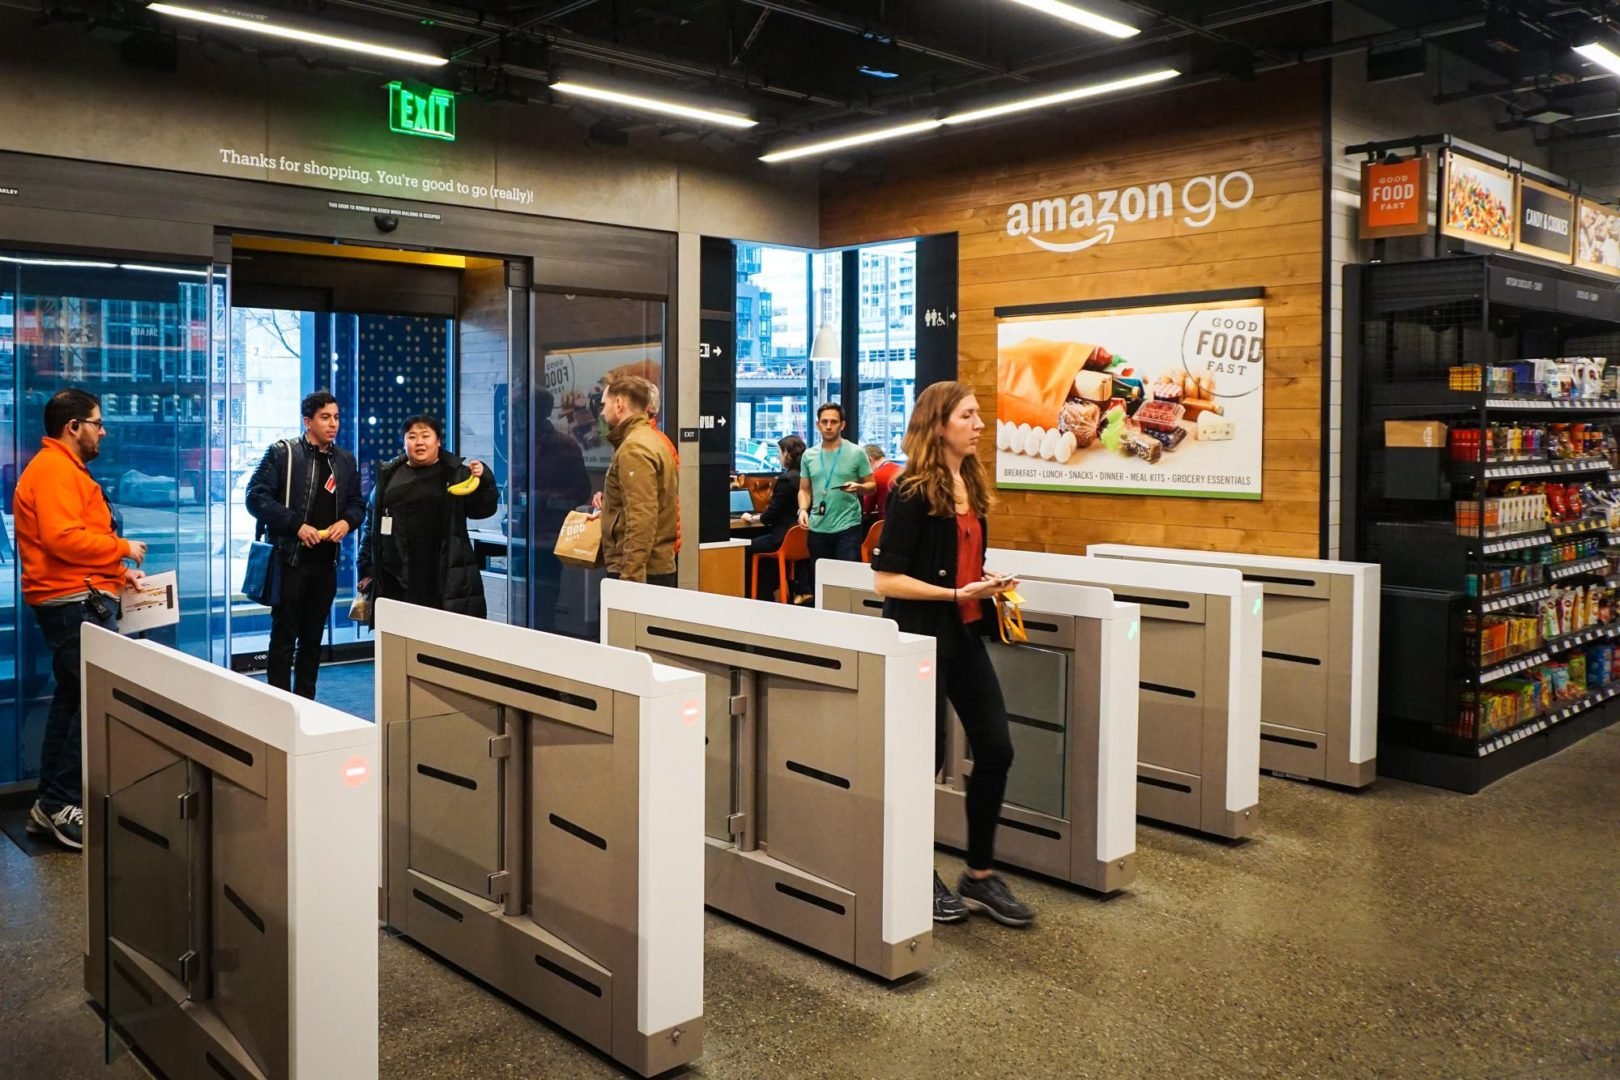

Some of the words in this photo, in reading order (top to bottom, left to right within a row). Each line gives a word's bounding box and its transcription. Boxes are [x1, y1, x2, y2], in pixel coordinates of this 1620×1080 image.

[401, 90, 449, 132] EXIT
[219, 149, 277, 169] Thanks
[279, 156, 301, 172] for
[303, 160, 373, 184] shopping.
[376, 170, 419, 188] You're
[422, 178, 454, 192] good
[456, 181, 470, 194] to
[472, 186, 488, 197] go
[489, 184, 534, 205] (really)!
[1378, 174, 1408, 184] GOOD
[1372, 183, 1415, 203] FOOD
[1006, 181, 1174, 237] amazon
[1182, 171, 1255, 228] go
[1379, 201, 1407, 211] FAST
[1526, 208, 1543, 229] CANDY
[1548, 214, 1569, 236] COOKIES
[1211, 317, 1258, 332] GOOD
[1196, 330, 1264, 363] FOOD
[1206, 360, 1247, 376] FAST
[1004, 468, 1037, 478] BREAKFAST
[1042, 469, 1063, 478] LUNCH
[1069, 470, 1094, 480] SNACKS
[1100, 471, 1124, 481] DINNER
[1130, 472, 1147, 482] MEAL
[1149, 473, 1166, 483] KITS
[1172, 473, 1205, 484] GROCERY
[1207, 474, 1252, 486] ESSENTIALS
[560, 523, 586, 537] FOOD
